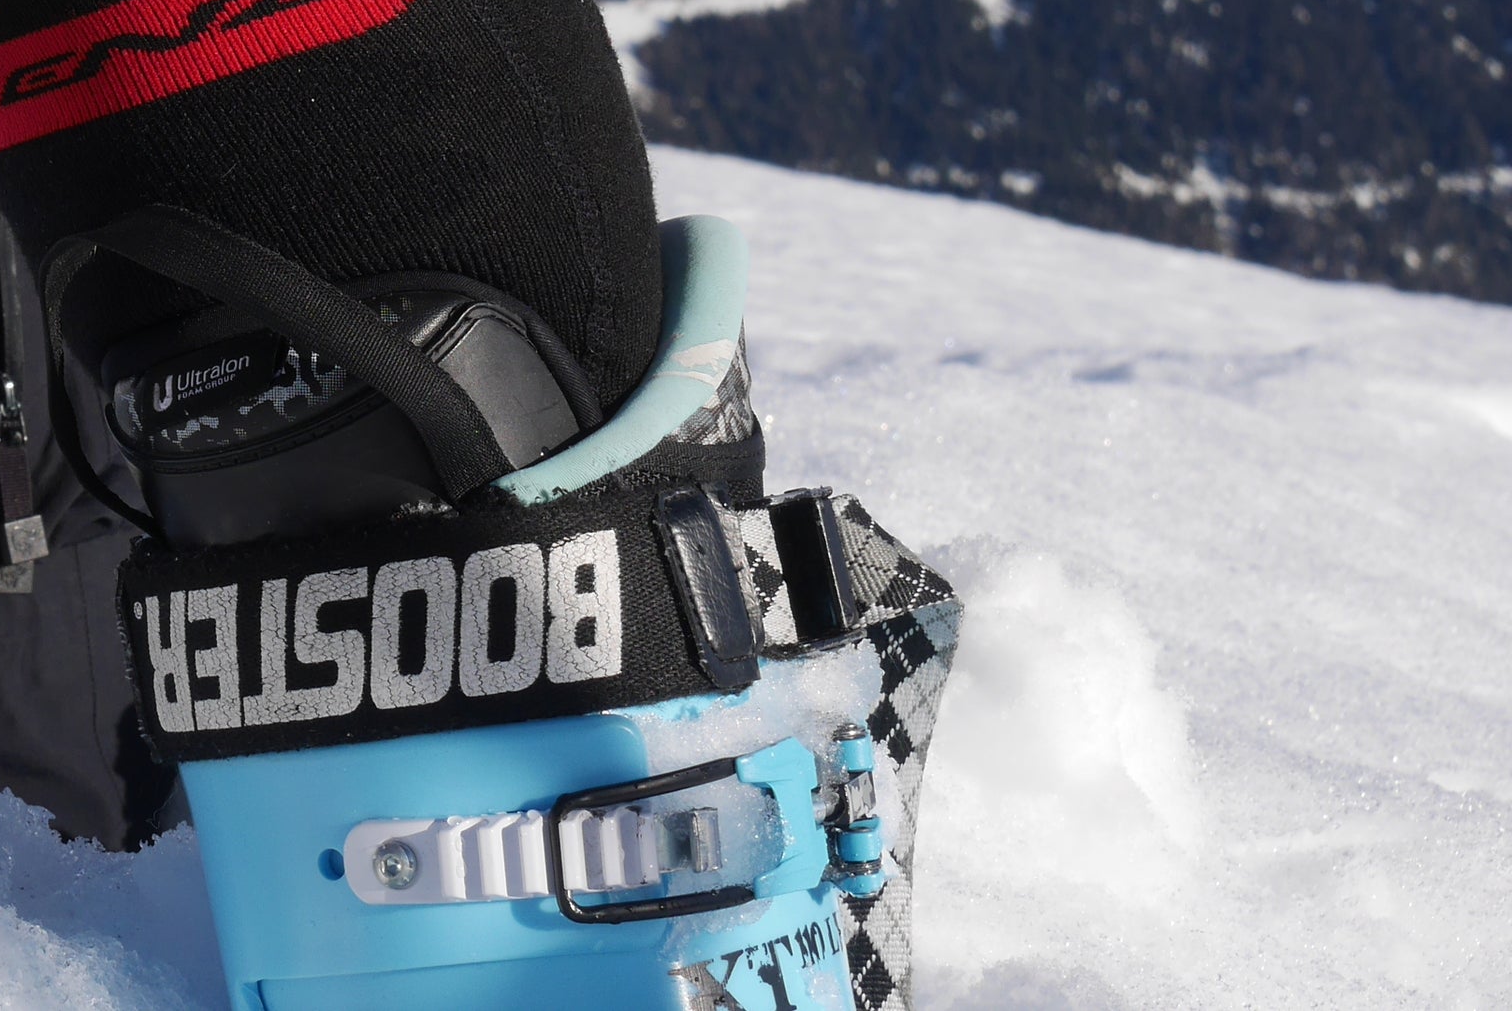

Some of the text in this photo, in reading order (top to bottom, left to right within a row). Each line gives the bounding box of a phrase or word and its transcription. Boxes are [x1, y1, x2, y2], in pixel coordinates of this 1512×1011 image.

[177, 355, 250, 391] Ultralon
[204, 373, 237, 390] GROUP
[145, 529, 622, 733] BOOSTER
